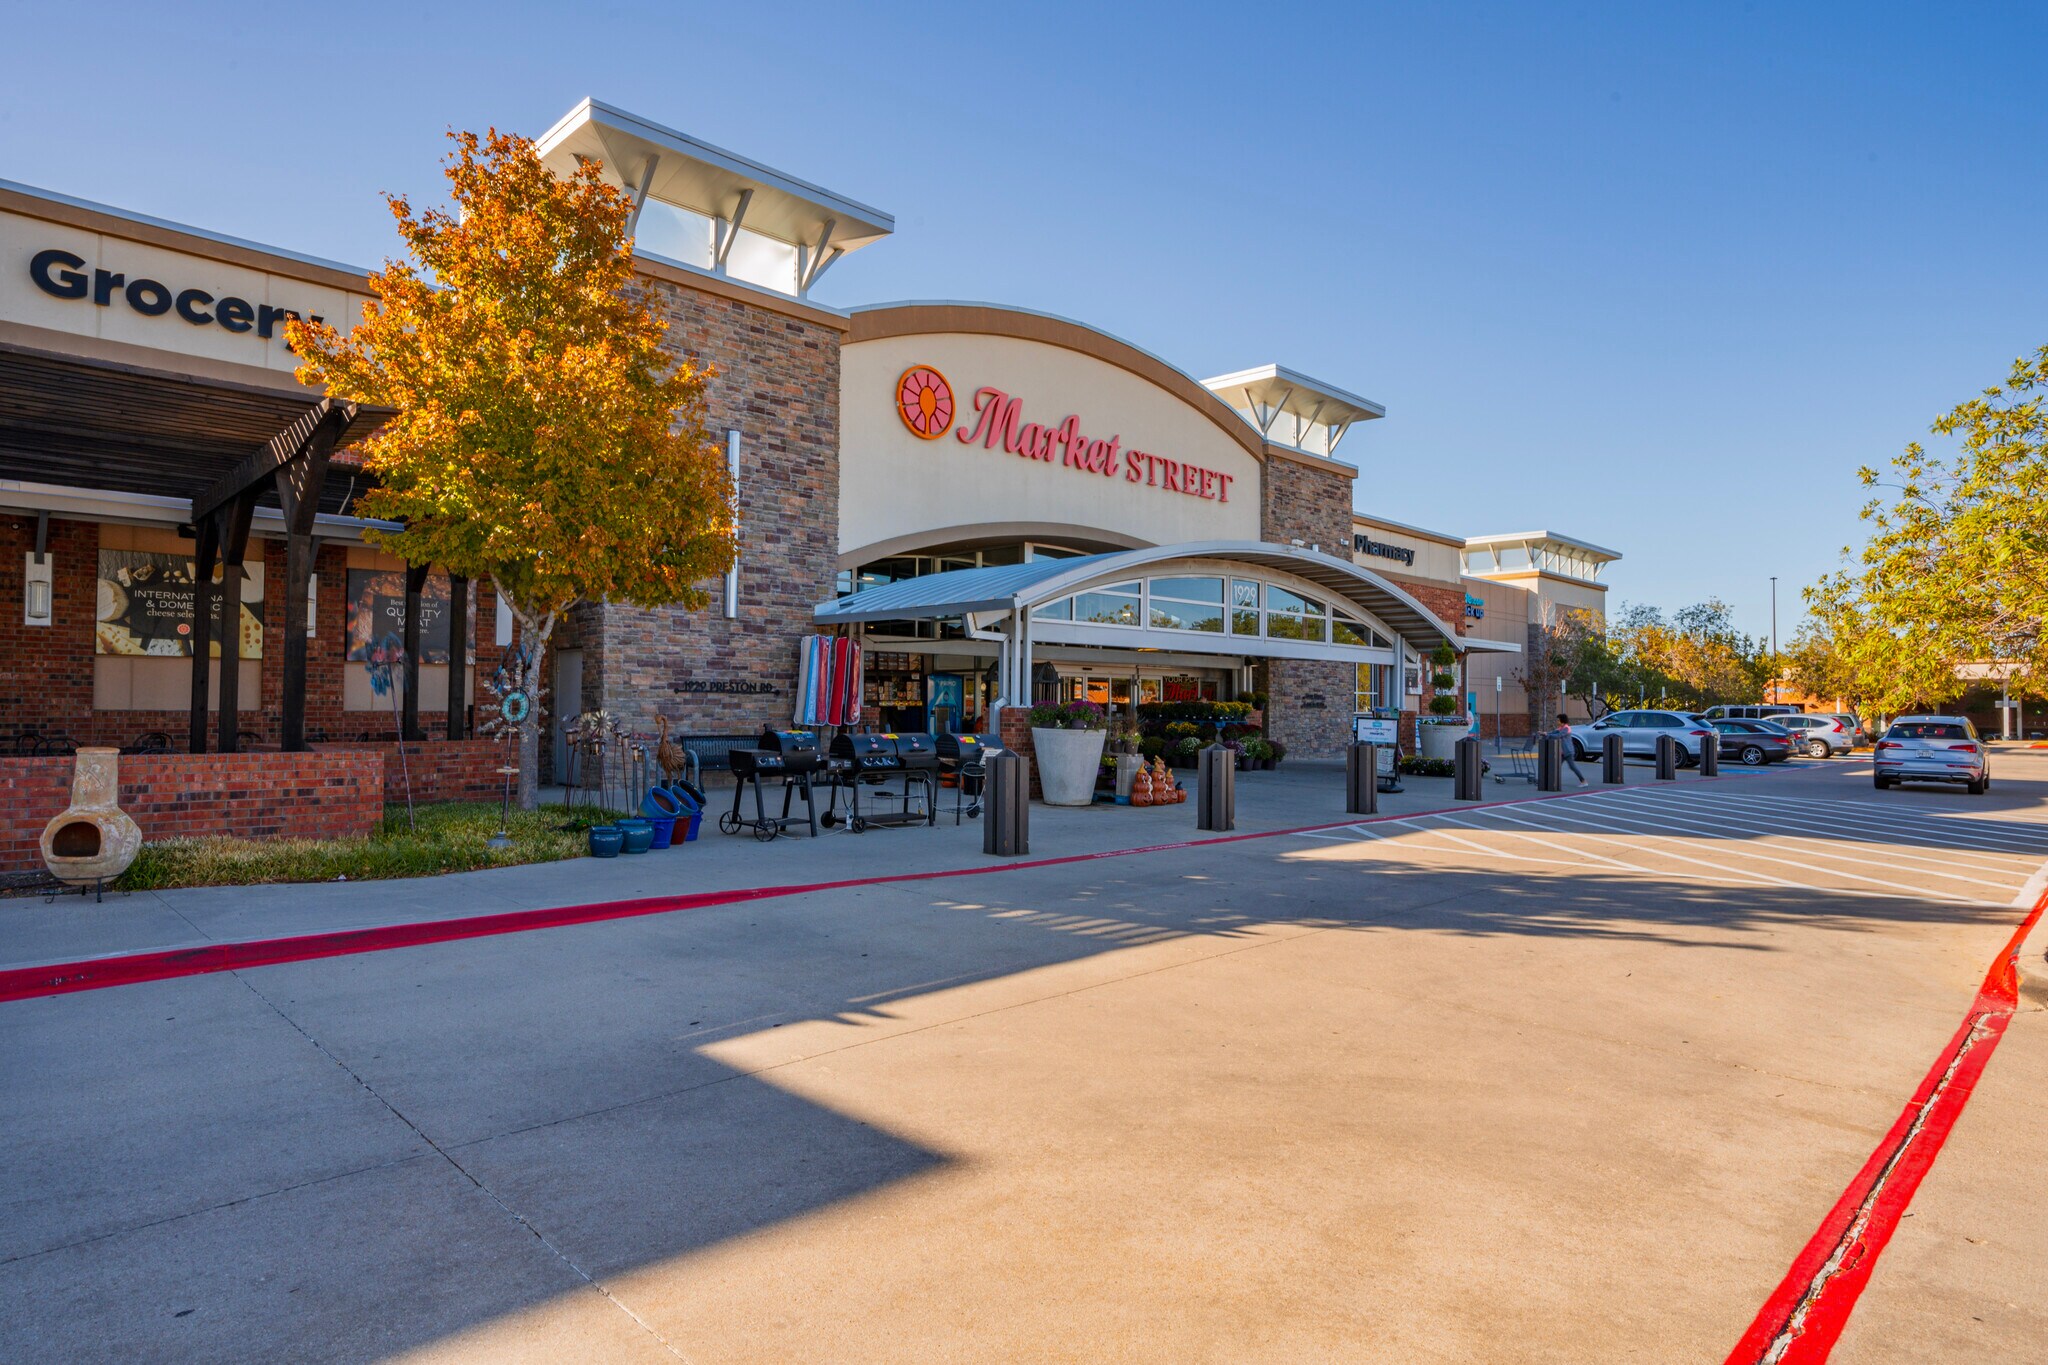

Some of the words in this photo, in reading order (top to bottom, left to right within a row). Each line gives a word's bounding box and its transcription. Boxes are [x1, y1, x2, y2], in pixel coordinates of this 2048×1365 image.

[957, 386, 1121, 477] Market
[1126, 449, 1234, 503] STREET
[1354, 534, 1415, 566] Pharmacy
[134, 589, 224, 603] INTERNATNA
[1234, 584, 1257, 603] 1929
[146, 600, 155, 608] &
[159, 600, 221, 611] DOMEIC
[146, 608, 175, 617] cheese
[177, 610, 219, 620] seles.
[386, 607, 441, 619] QUITY
[1475, 608, 1485, 619] up
[397, 617, 431, 627] MAT
[684, 681, 706, 692] 1929
[709, 681, 757, 693] PRESTON
[760, 682, 773, 692] RD
